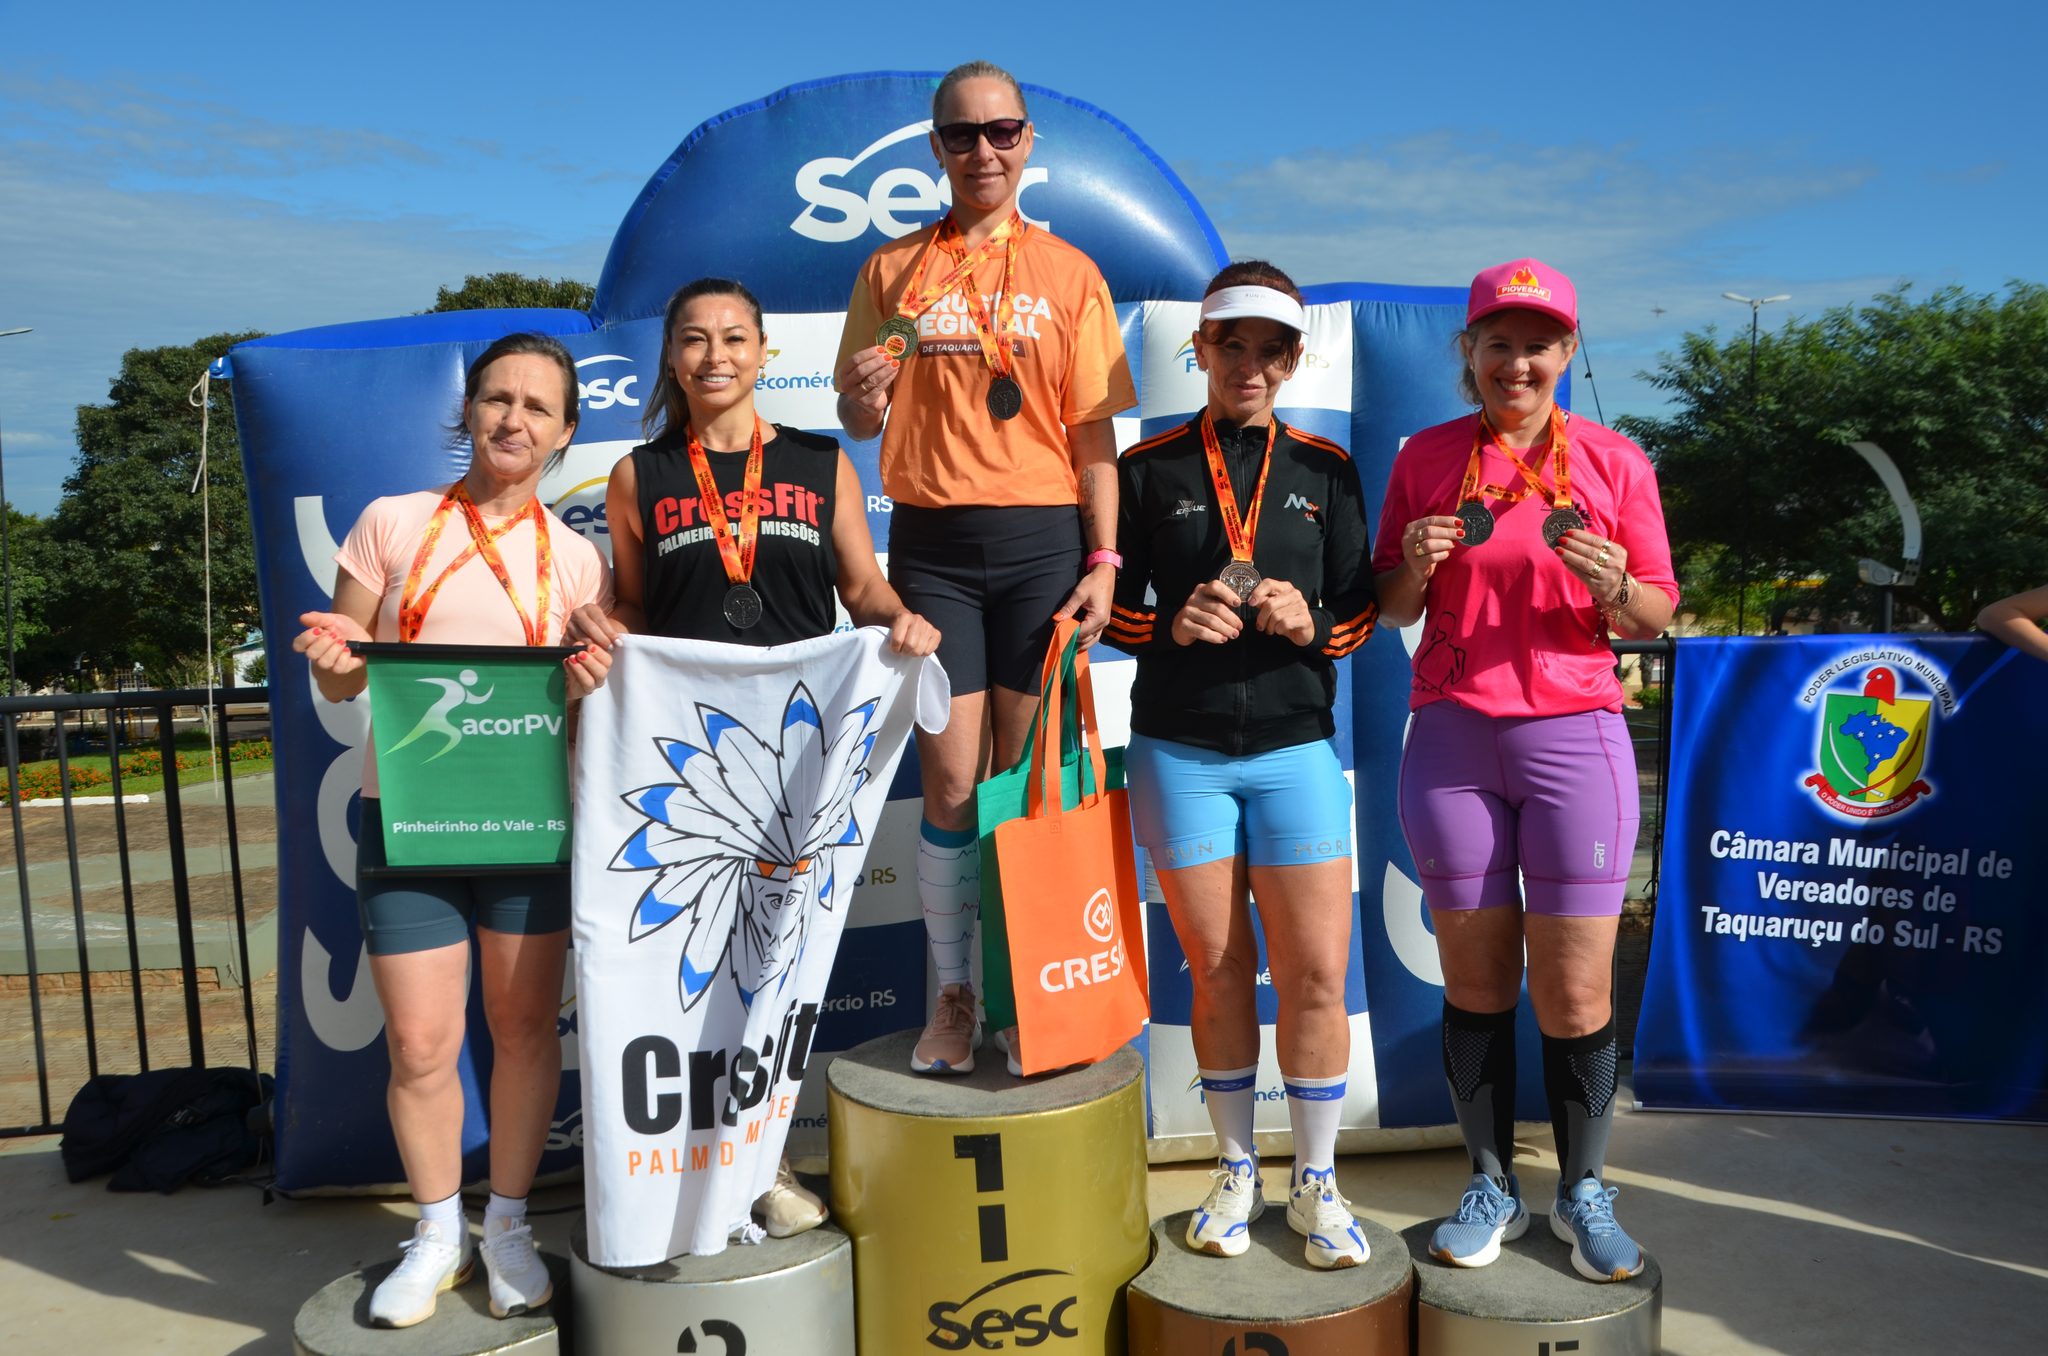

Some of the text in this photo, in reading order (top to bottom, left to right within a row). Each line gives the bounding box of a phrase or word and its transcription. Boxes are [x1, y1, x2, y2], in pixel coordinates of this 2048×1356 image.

[1502, 285, 1546, 297] PIOVESAN
[923, 345, 933, 353] DE
[936, 343, 982, 352] TAQUARU
[867, 495, 893, 513] RS
[760, 520, 820, 547] MISSÕES
[1803, 651, 1955, 714] PODER LEGISLATIVO MUNICIPAL
[462, 713, 563, 736] acorPV
[1825, 796, 1846, 812] PODER
[1845, 806, 1867, 816] UNIDO
[393, 820, 478, 833] Pinheirinho
[482, 820, 500, 832] do
[503, 819, 534, 832] Vale
[547, 819, 566, 831] RS
[1167, 838, 1213, 864] RUN
[1593, 841, 1606, 869] GRIT
[1709, 830, 2013, 880] Câmara Municipal de
[871, 866, 897, 886] RS
[1757, 871, 1957, 914] Vereadores de
[1701, 906, 1842, 948] Taquaruçu
[1851, 917, 1884, 945] do
[1893, 918, 1938, 951] Sul
[1962, 925, 2003, 956] RS
[1040, 938, 1125, 993] CRES
[870, 989, 897, 1009] RS
[953, 1132, 1008, 1263] 1
